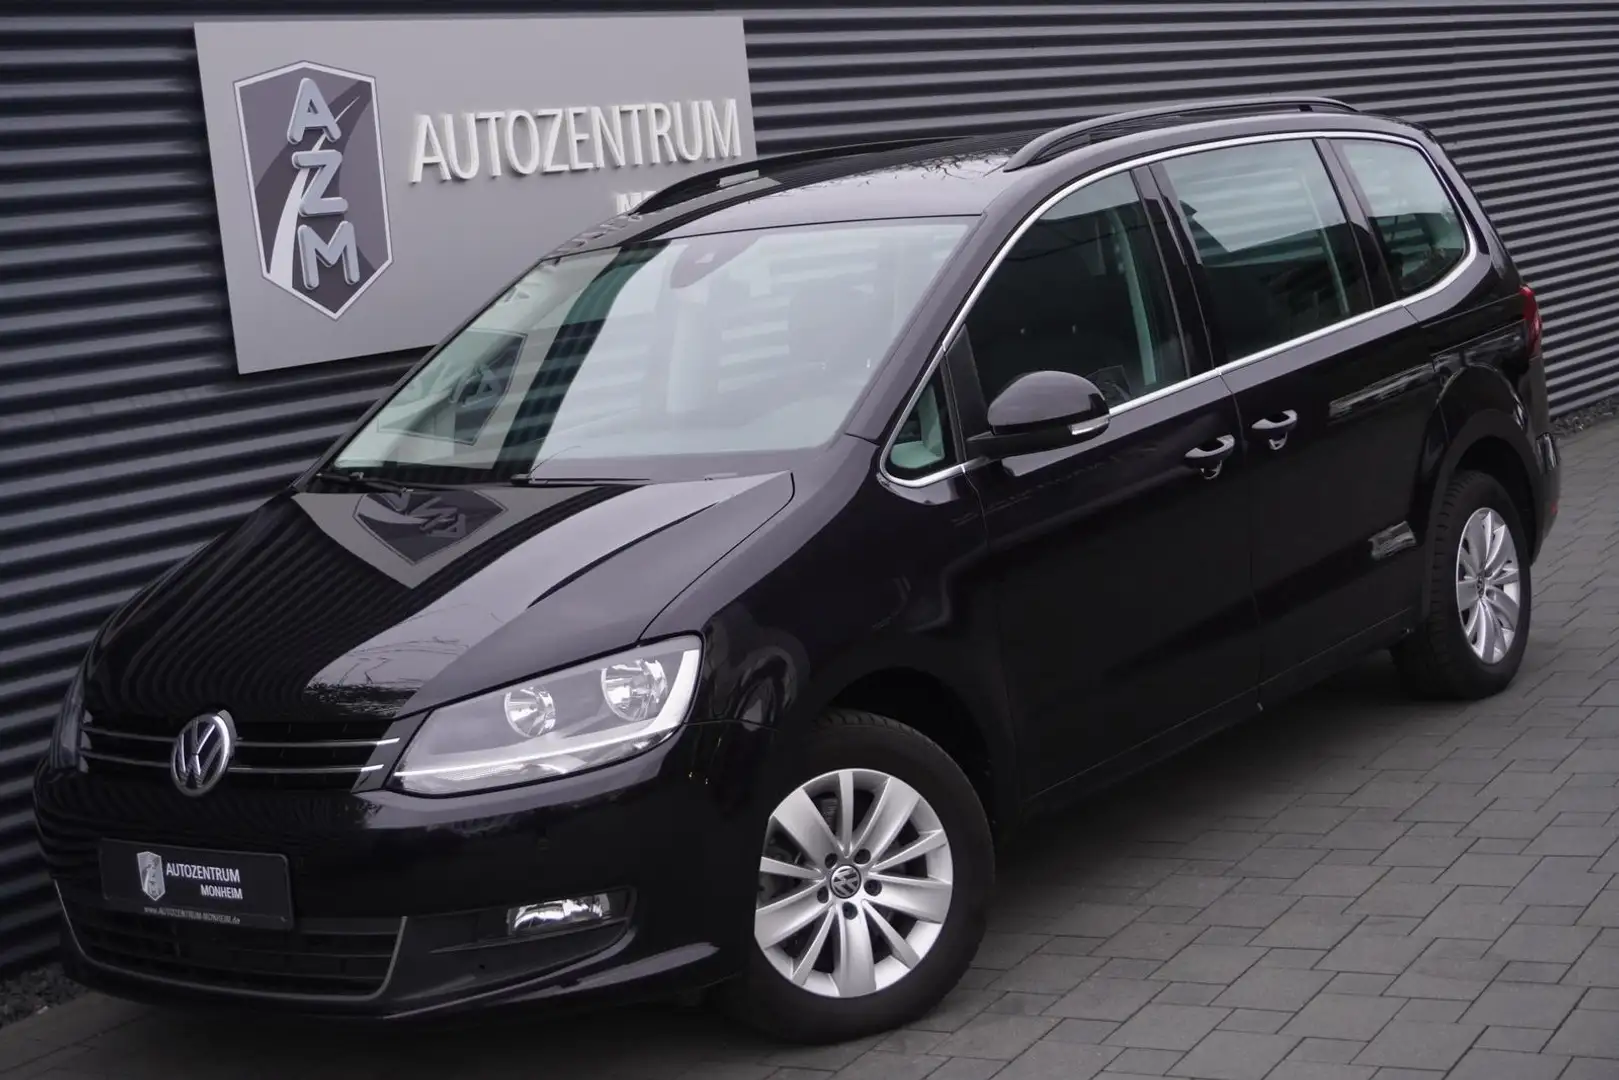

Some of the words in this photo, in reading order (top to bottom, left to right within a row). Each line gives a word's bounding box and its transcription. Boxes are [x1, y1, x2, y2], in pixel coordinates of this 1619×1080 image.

[410, 99, 741, 183] AUTOZENTRUM
[166, 863, 240, 882] AUTOZENTRUM
[200, 884, 243, 899] MONHEIM
